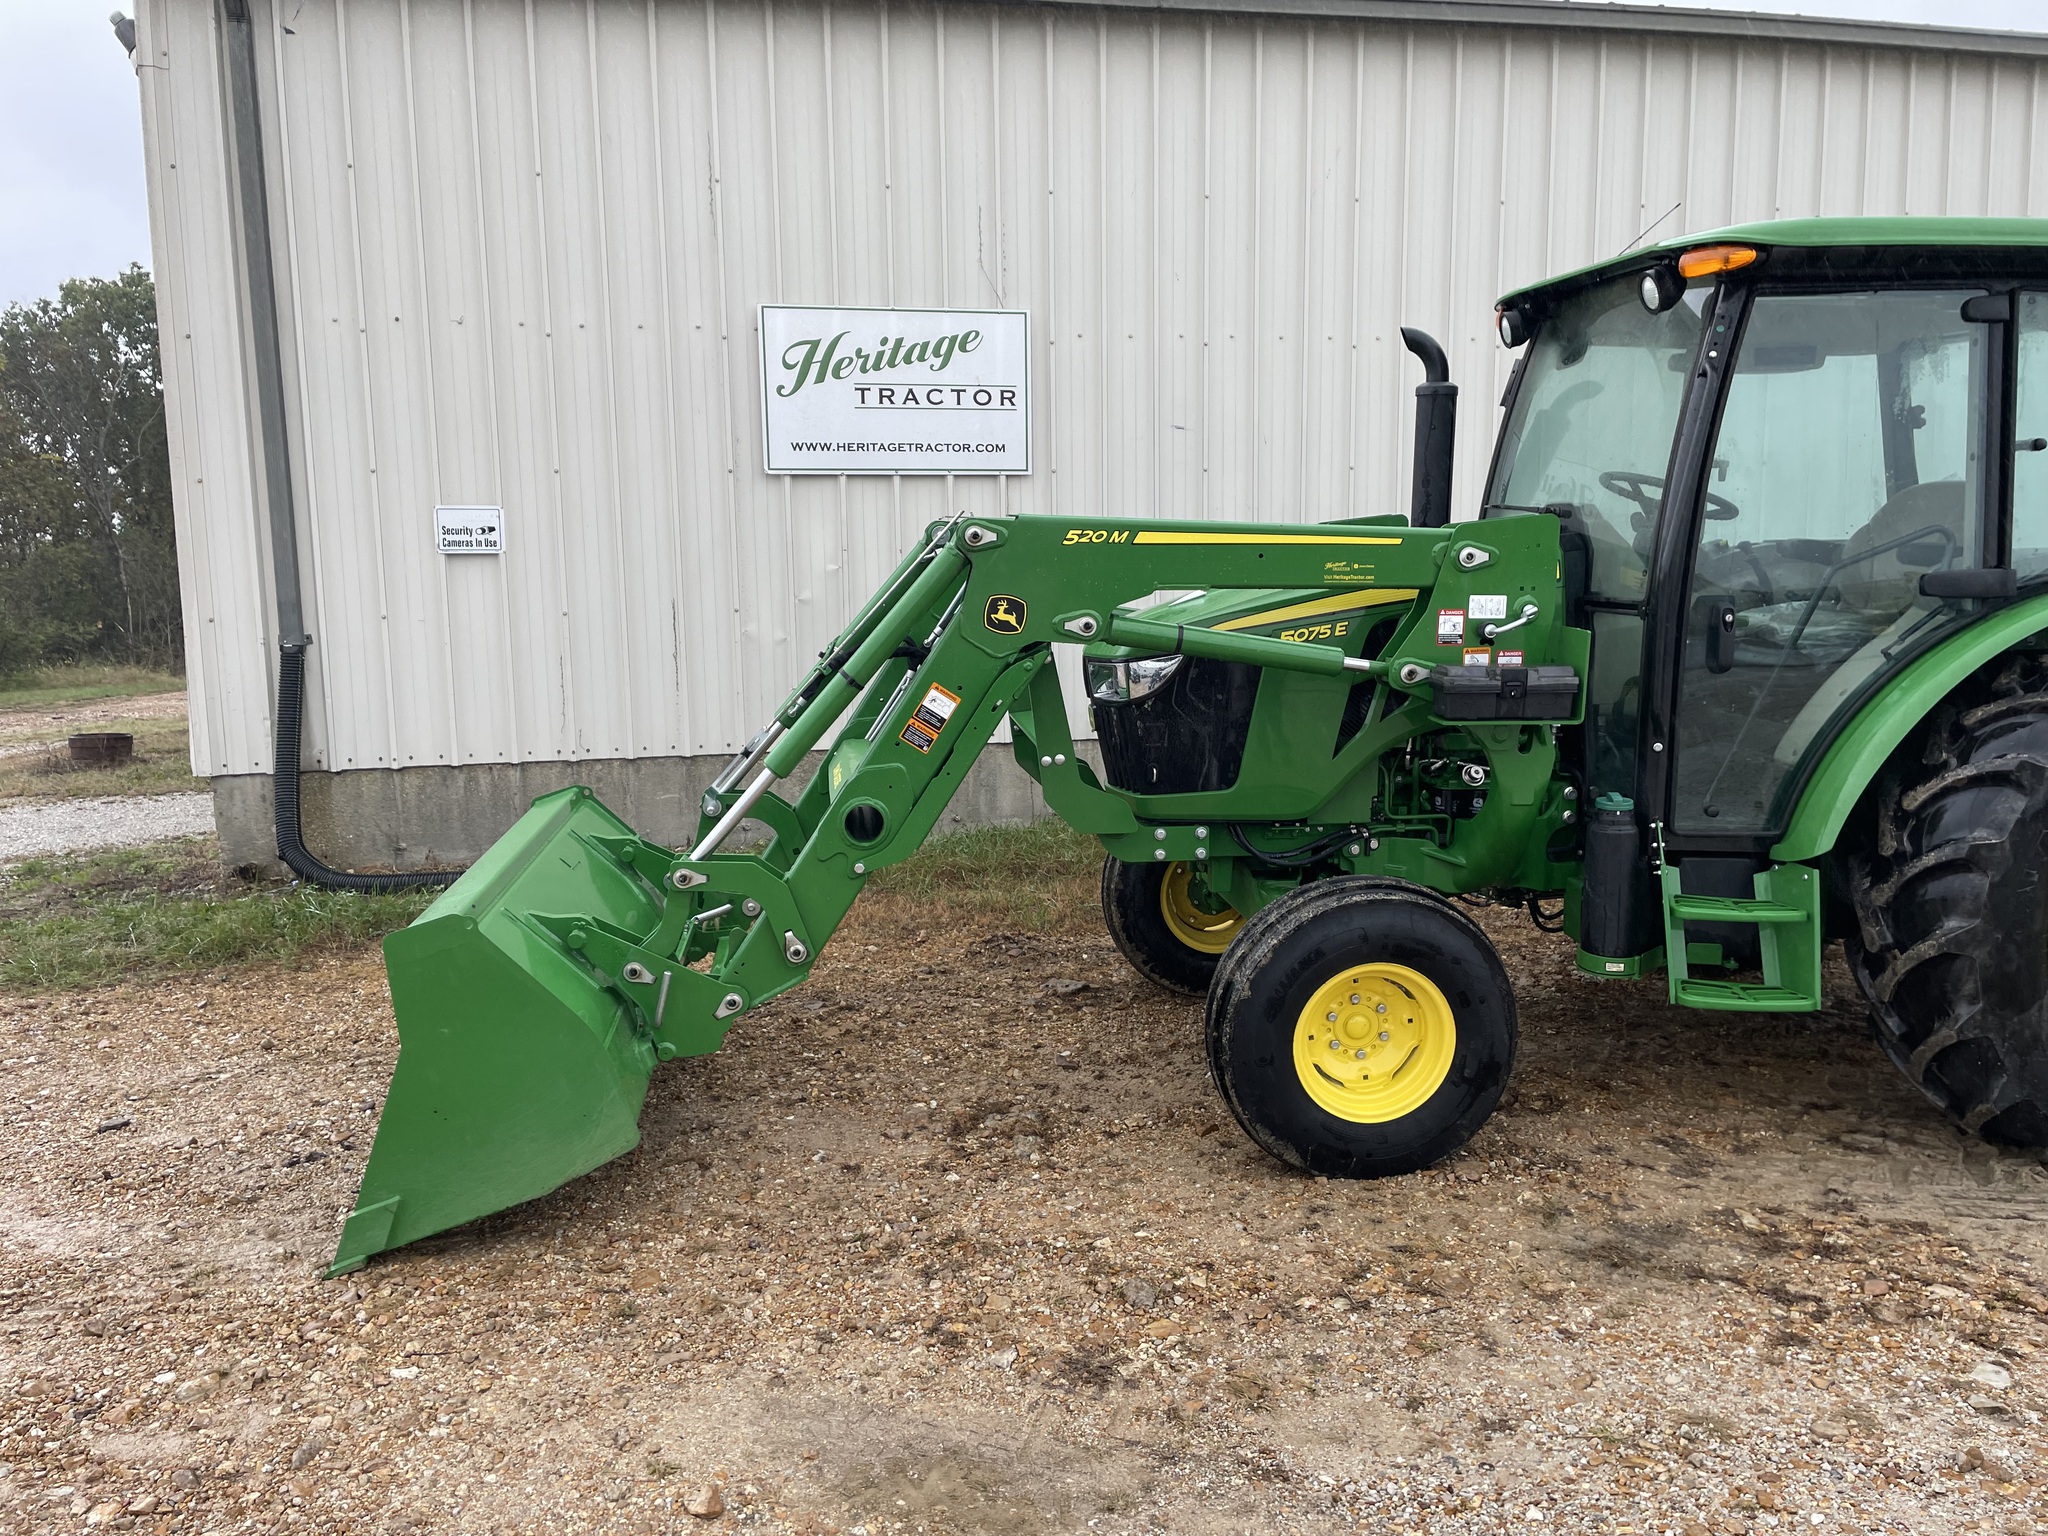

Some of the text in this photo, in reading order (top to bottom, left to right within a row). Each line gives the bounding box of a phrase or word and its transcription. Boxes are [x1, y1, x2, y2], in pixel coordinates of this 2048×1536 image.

[776, 330, 984, 398] Heritage
[854, 387, 1017, 407] TRACTOR
[790, 441, 1006, 453] WWW.HERITAGETRACTOR.COM
[441, 525, 473, 537] Security
[442, 537, 498, 548] Cameras In Use
